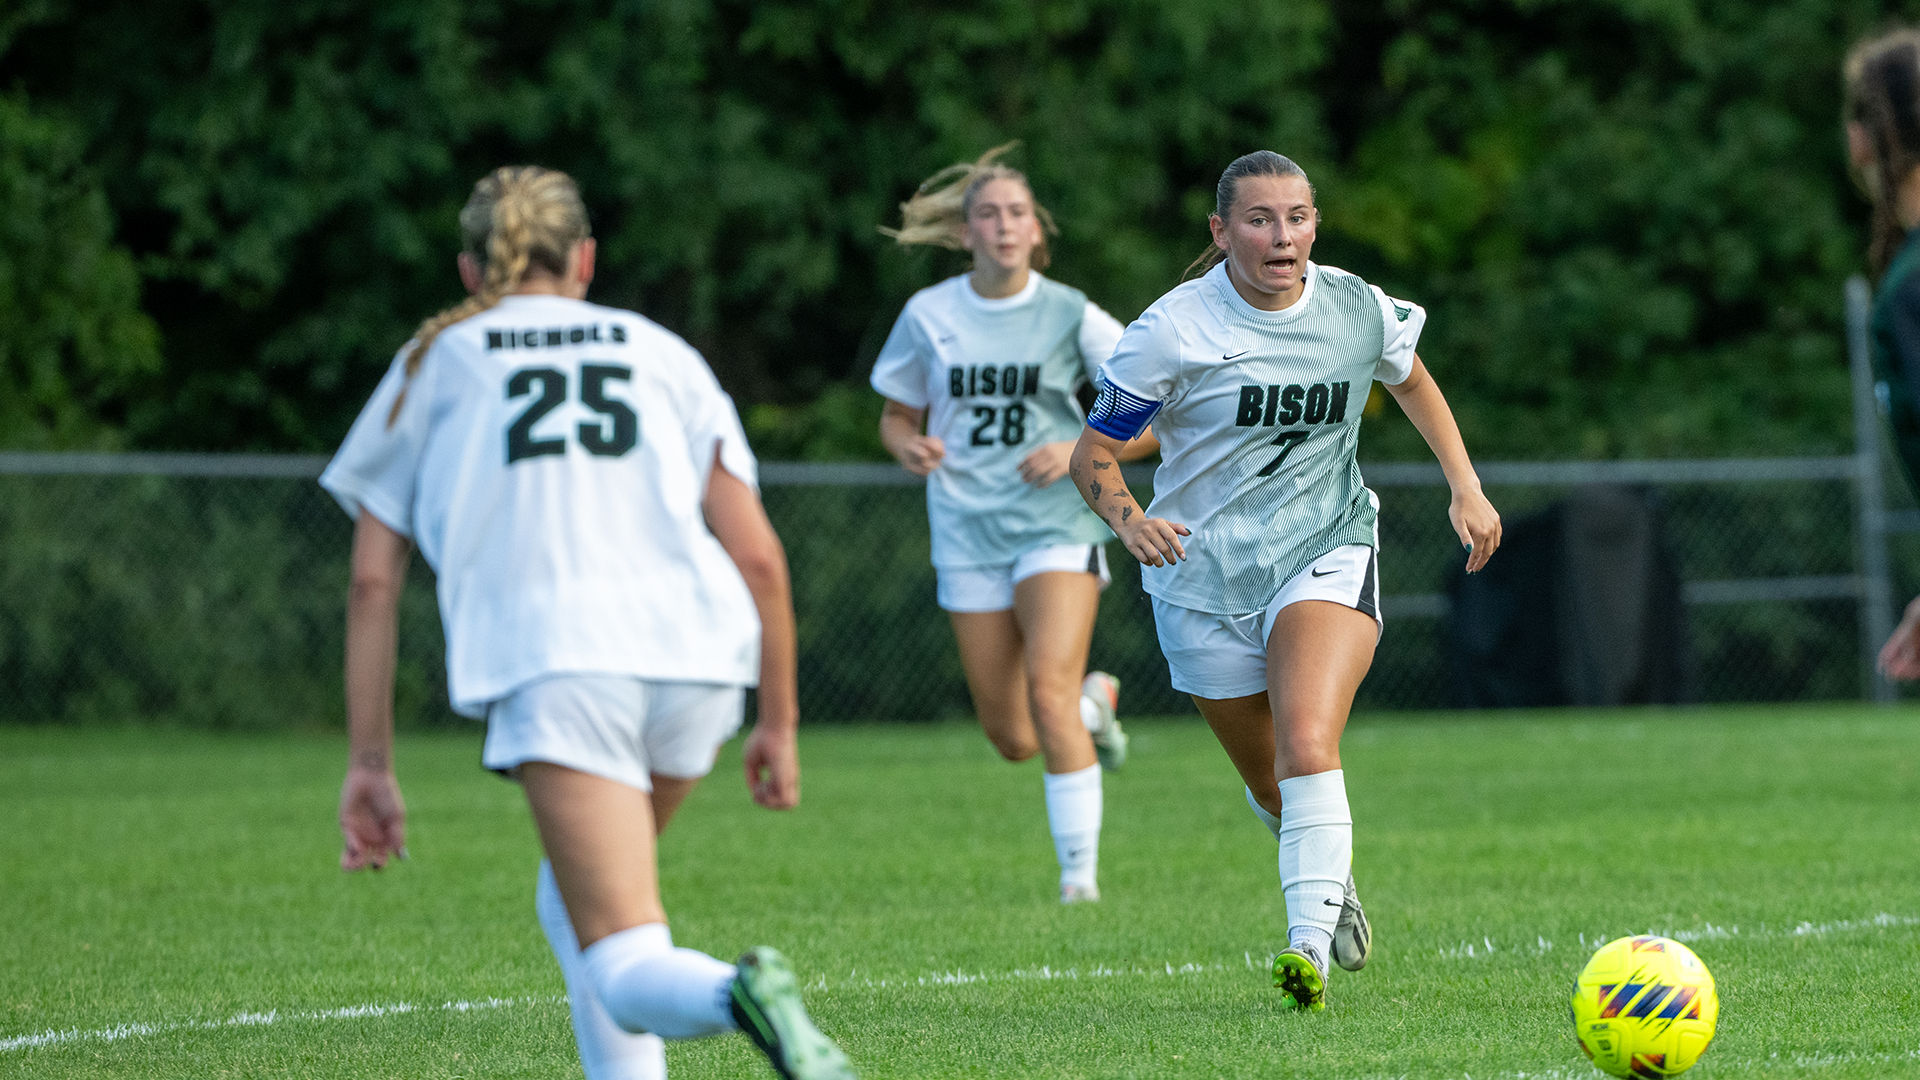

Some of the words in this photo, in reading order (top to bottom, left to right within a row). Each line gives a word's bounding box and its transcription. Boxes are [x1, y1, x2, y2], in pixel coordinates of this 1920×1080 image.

[950, 365, 1041, 397] BISON
[1235, 381, 1350, 426] BISON
[506, 364, 637, 464] 25
[971, 402, 1027, 446] 28
[1256, 430, 1310, 477] 7
